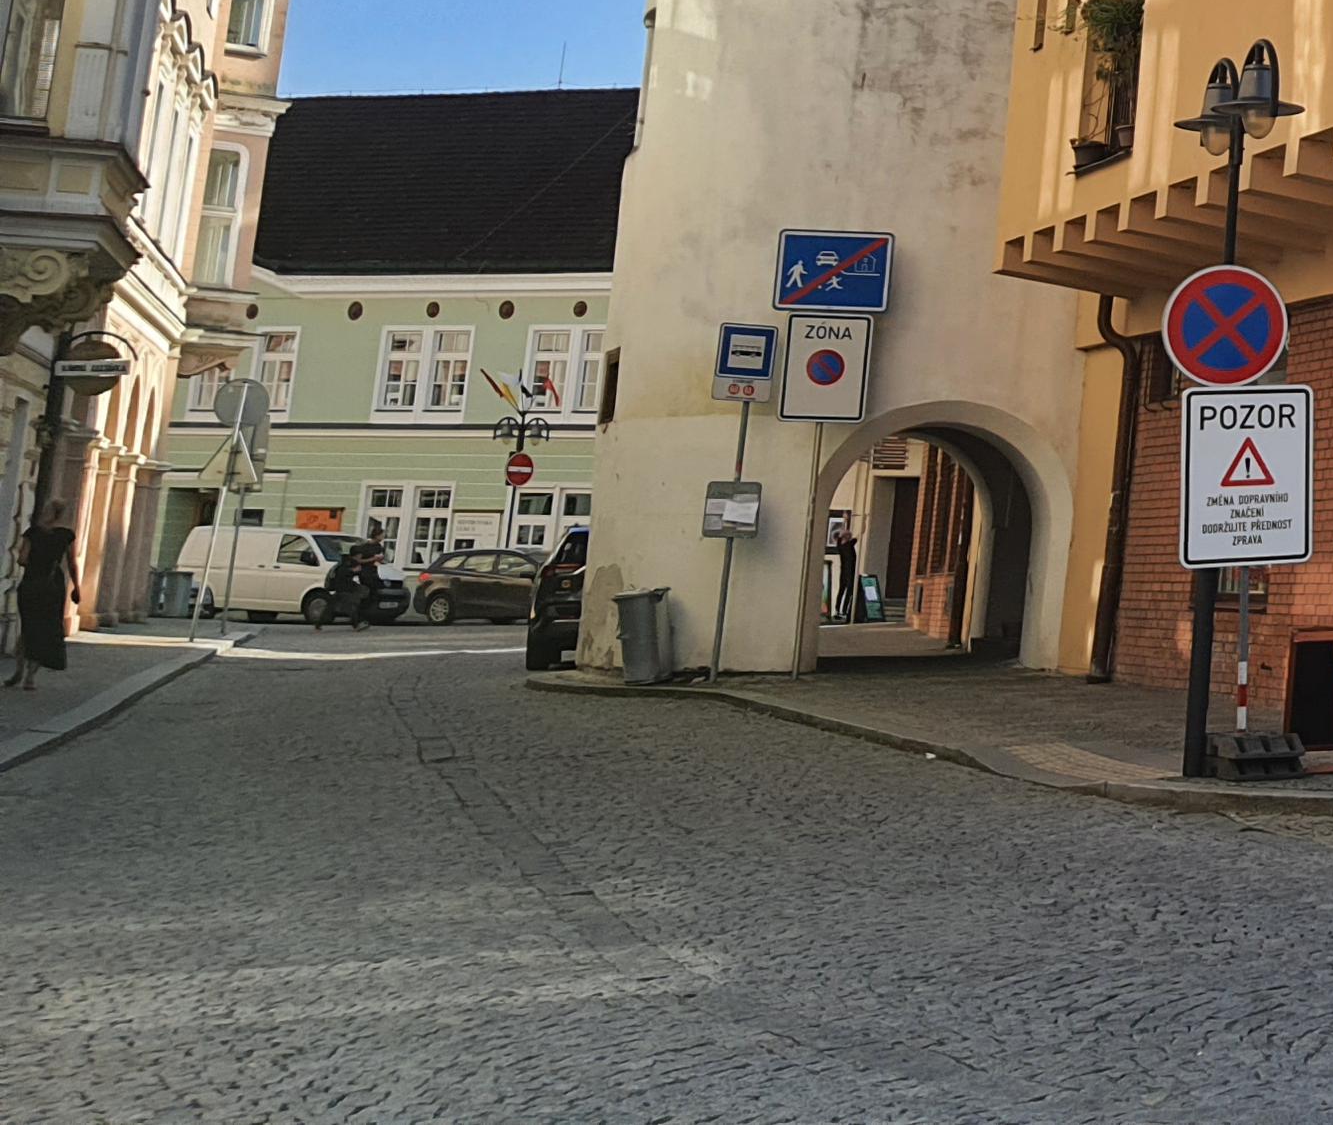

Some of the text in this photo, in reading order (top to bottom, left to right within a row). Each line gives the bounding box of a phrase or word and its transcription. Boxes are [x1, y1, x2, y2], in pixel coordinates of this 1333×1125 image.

[804, 321, 853, 340] ZÓNA
[1199, 403, 1297, 431] POZOR
[1207, 491, 1289, 507] ZMĚNA DOPRAVNÍHO
[1230, 505, 1265, 519] ZNAČENÍ
[1202, 518, 1293, 534] DODRŽUJTE PŘEDNOST
[1232, 535, 1263, 547] ZPRAVA
